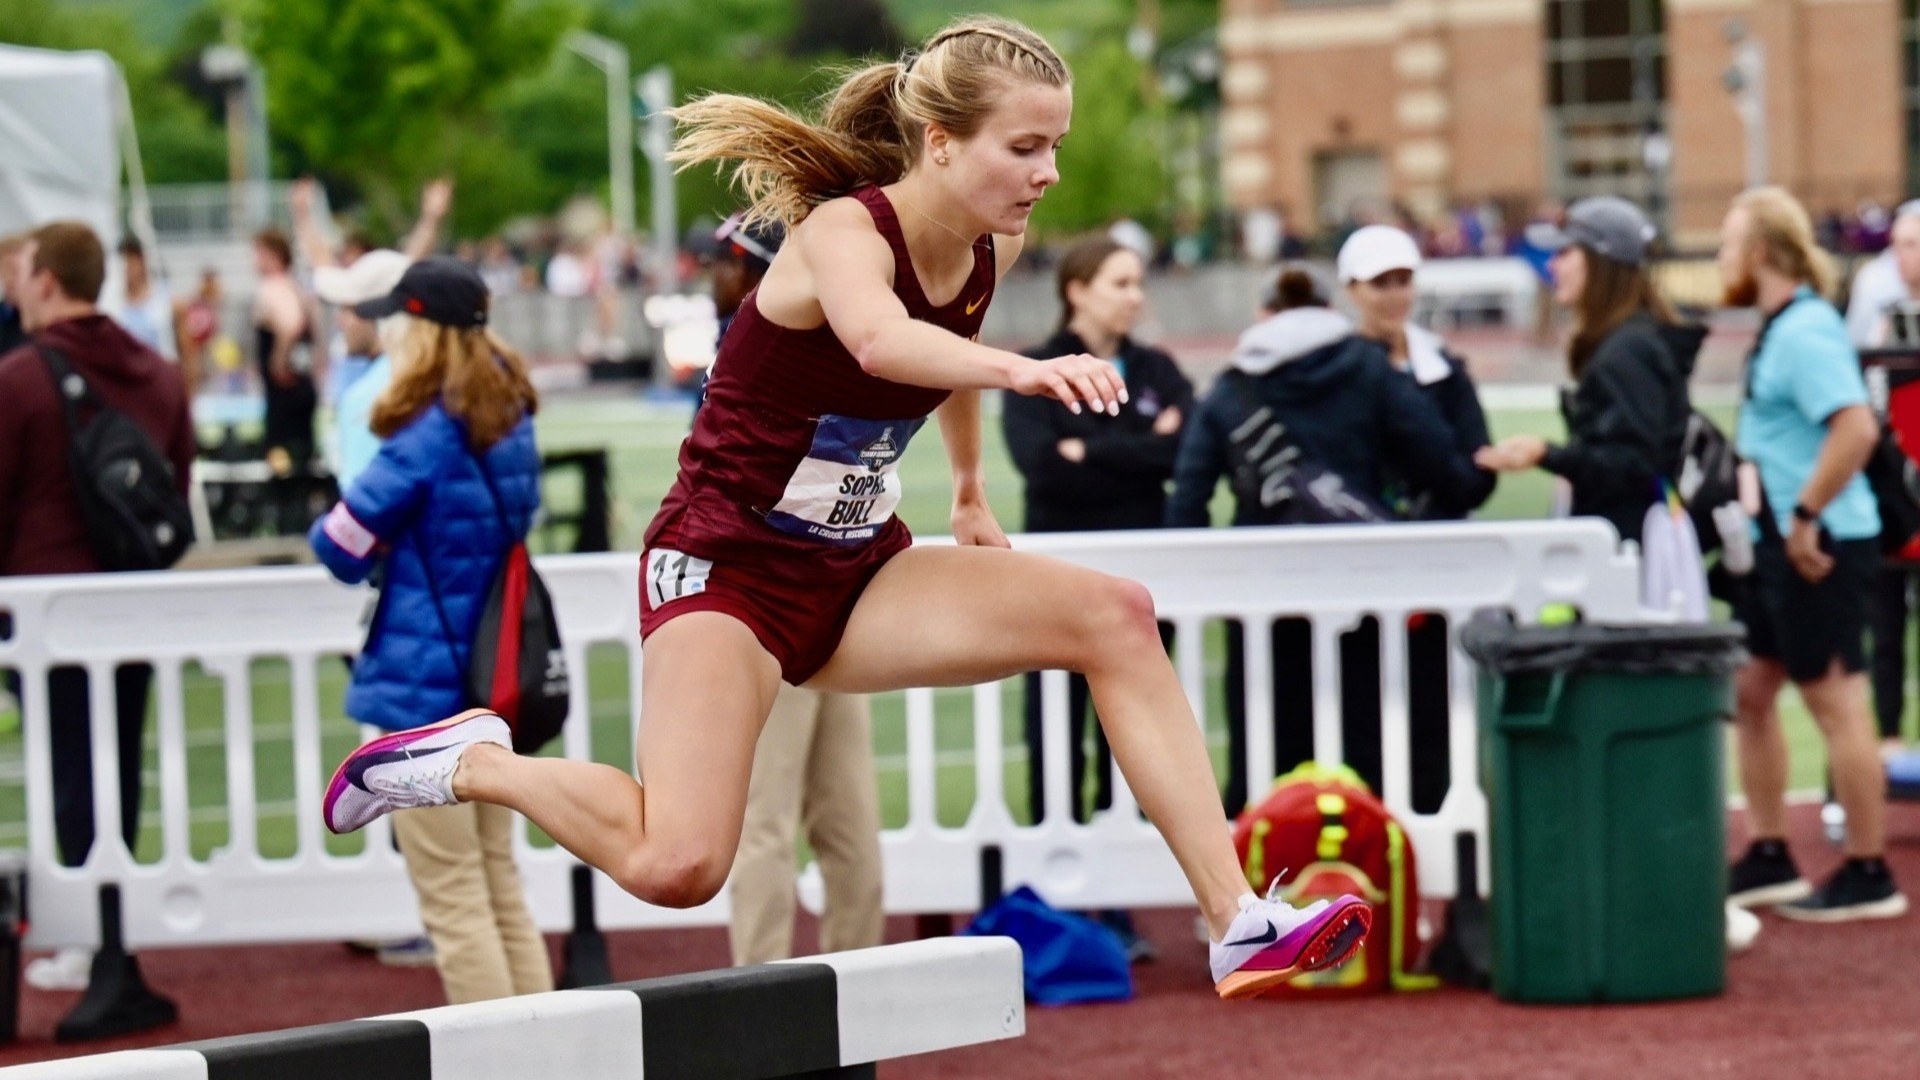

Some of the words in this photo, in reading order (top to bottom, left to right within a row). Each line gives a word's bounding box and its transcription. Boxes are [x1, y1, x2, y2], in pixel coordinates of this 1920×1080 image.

[827, 500, 874, 525] BULL
[808, 525, 818, 534] LA
[653, 554, 690, 603] 11
